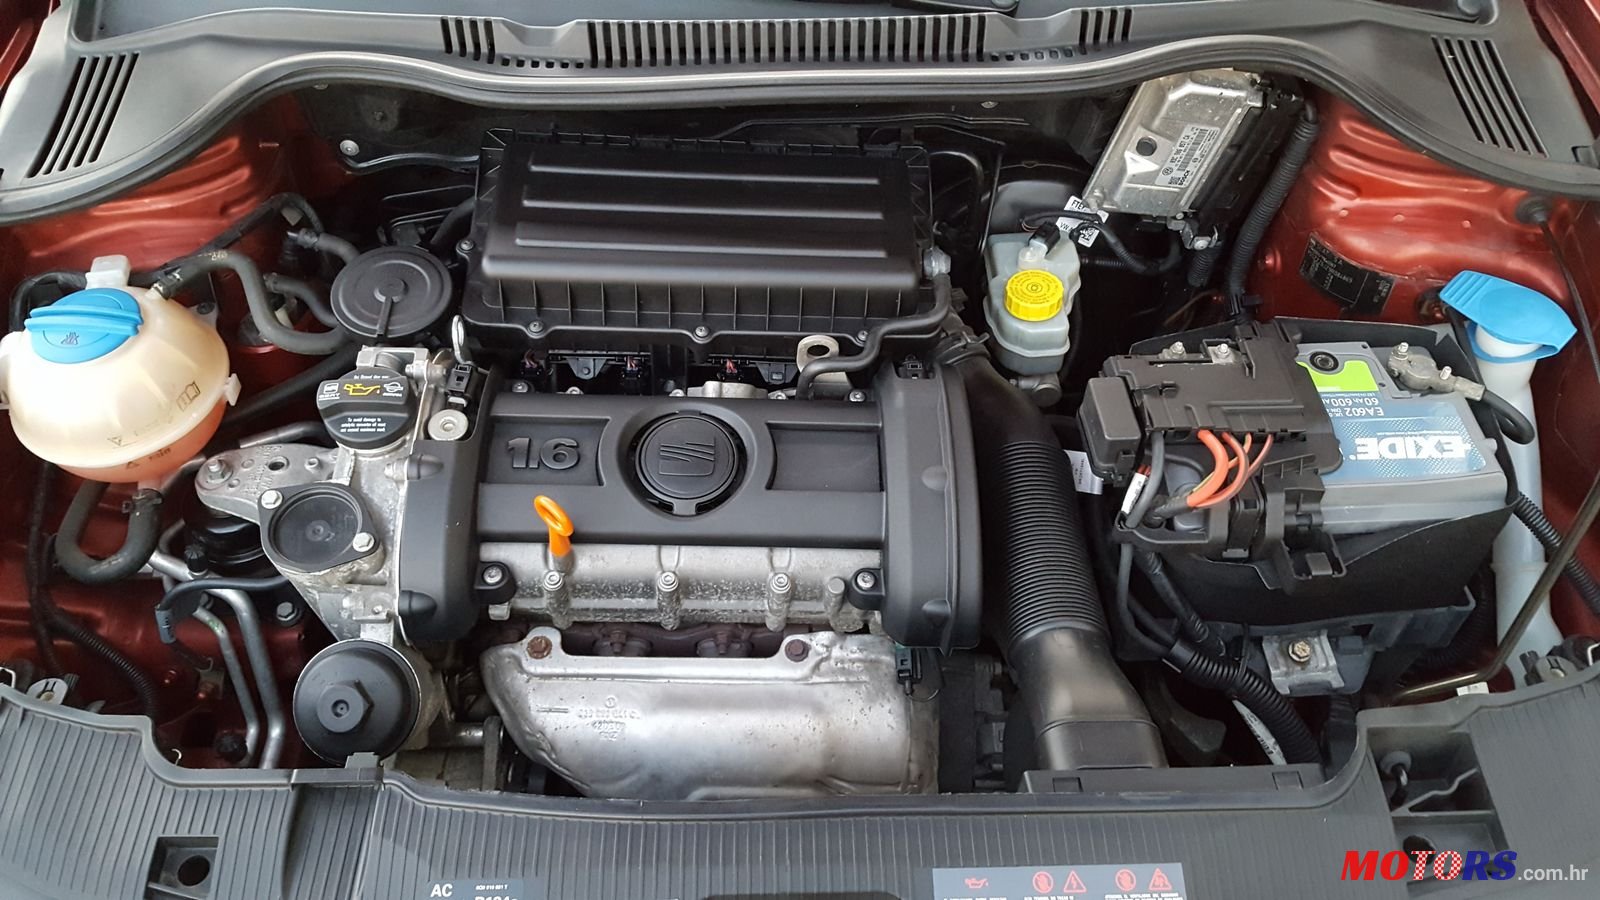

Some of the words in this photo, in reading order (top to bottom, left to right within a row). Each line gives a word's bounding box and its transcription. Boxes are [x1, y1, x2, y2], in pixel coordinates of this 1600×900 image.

[1343, 406, 1385, 416] EA602
[507, 437, 581, 470] 1.6
[1355, 436, 1468, 460] EXIDE
[430, 883, 453, 898] AC
